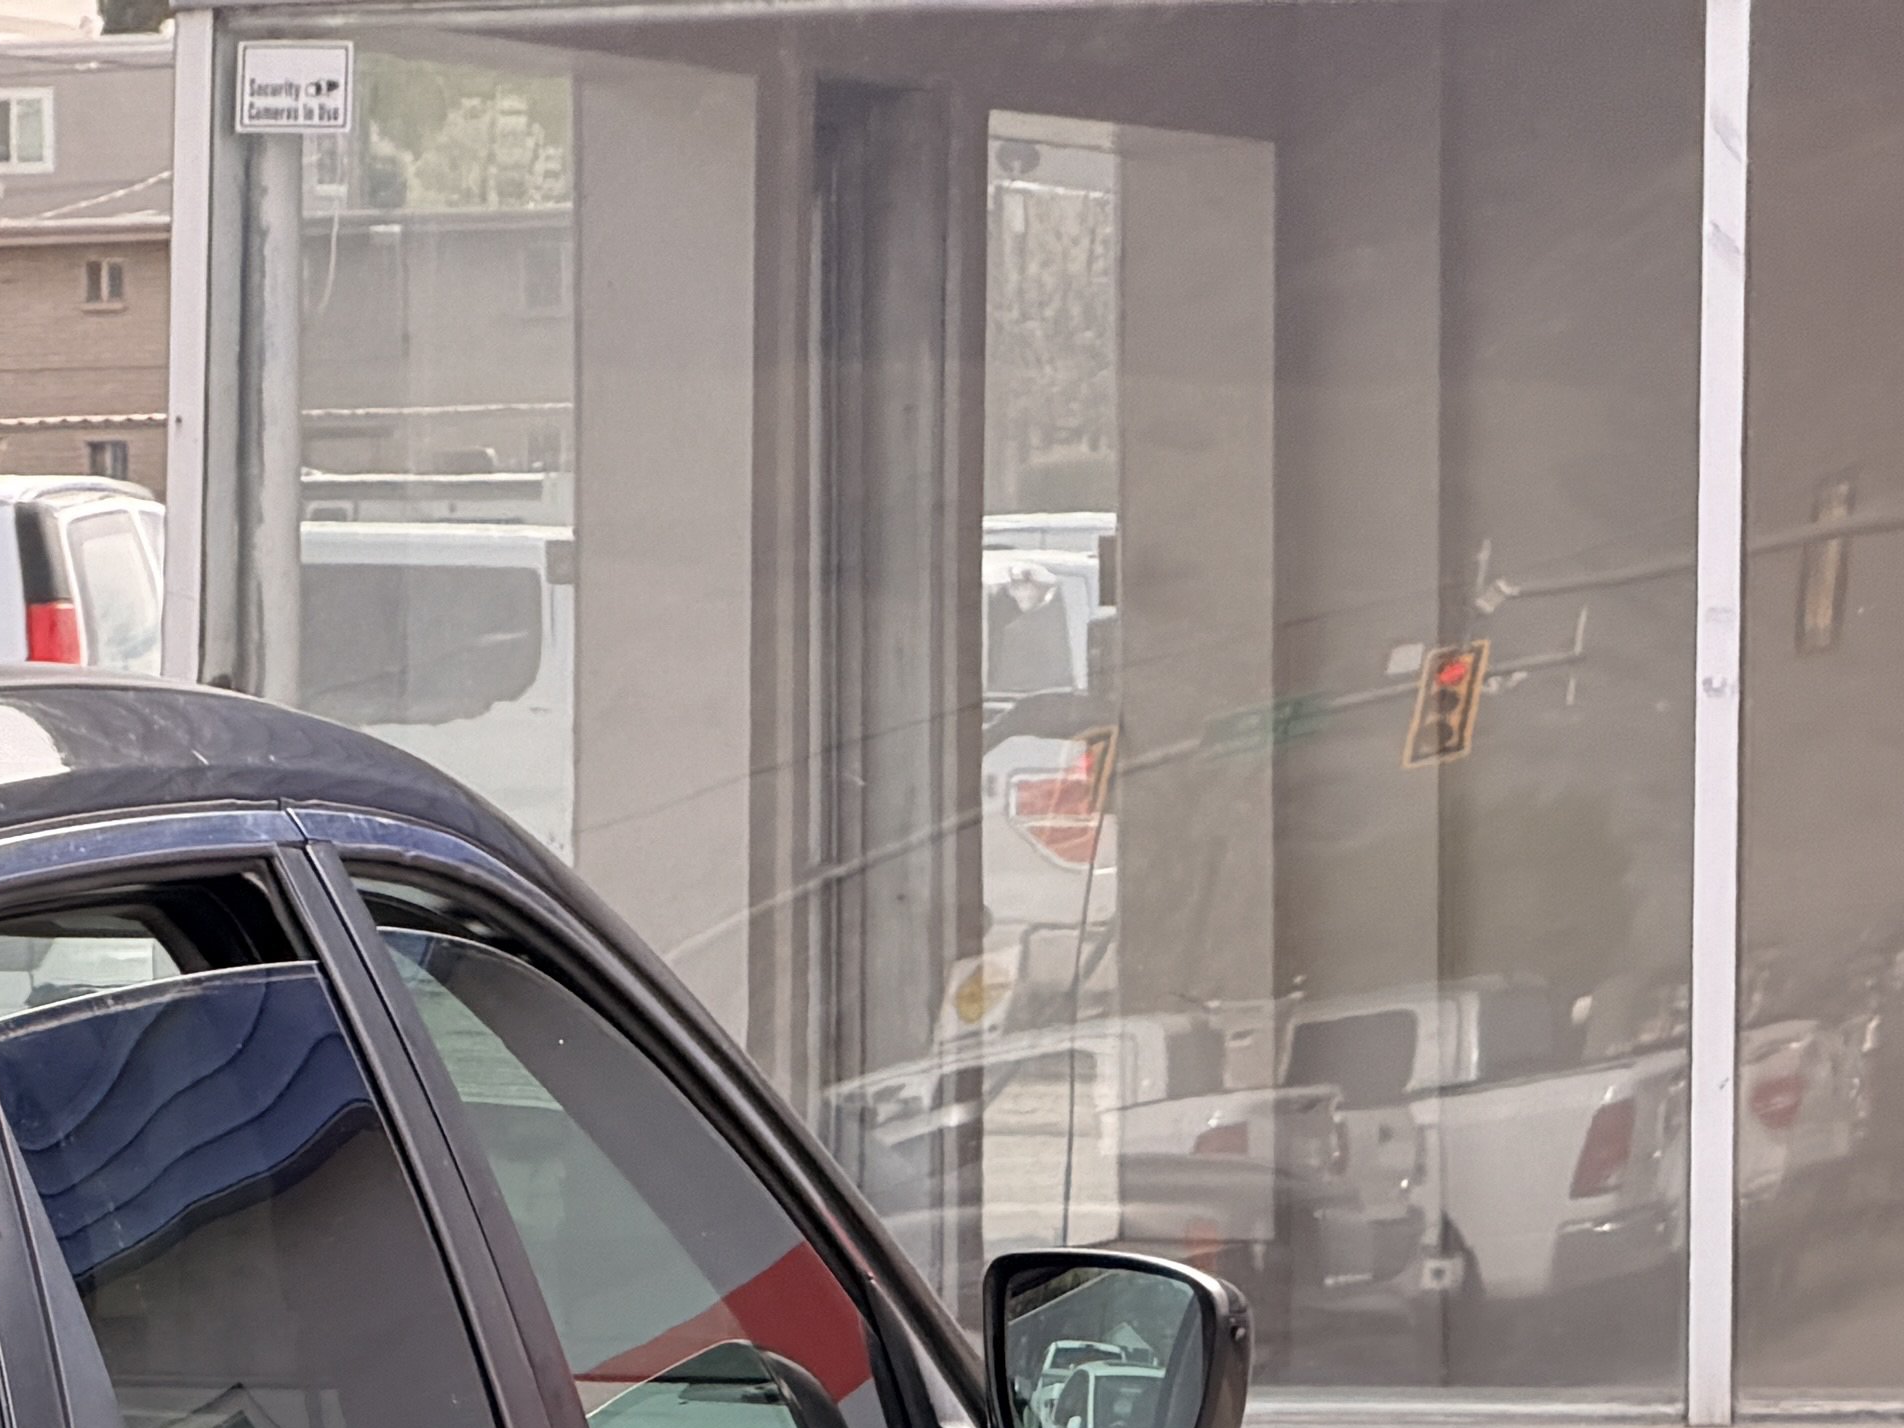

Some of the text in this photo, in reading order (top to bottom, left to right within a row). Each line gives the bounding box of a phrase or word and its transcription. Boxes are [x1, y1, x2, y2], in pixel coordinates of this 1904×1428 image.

[249, 78, 300, 101] Security
[248, 101, 299, 121] Cameras
[318, 103, 339, 121] Use
